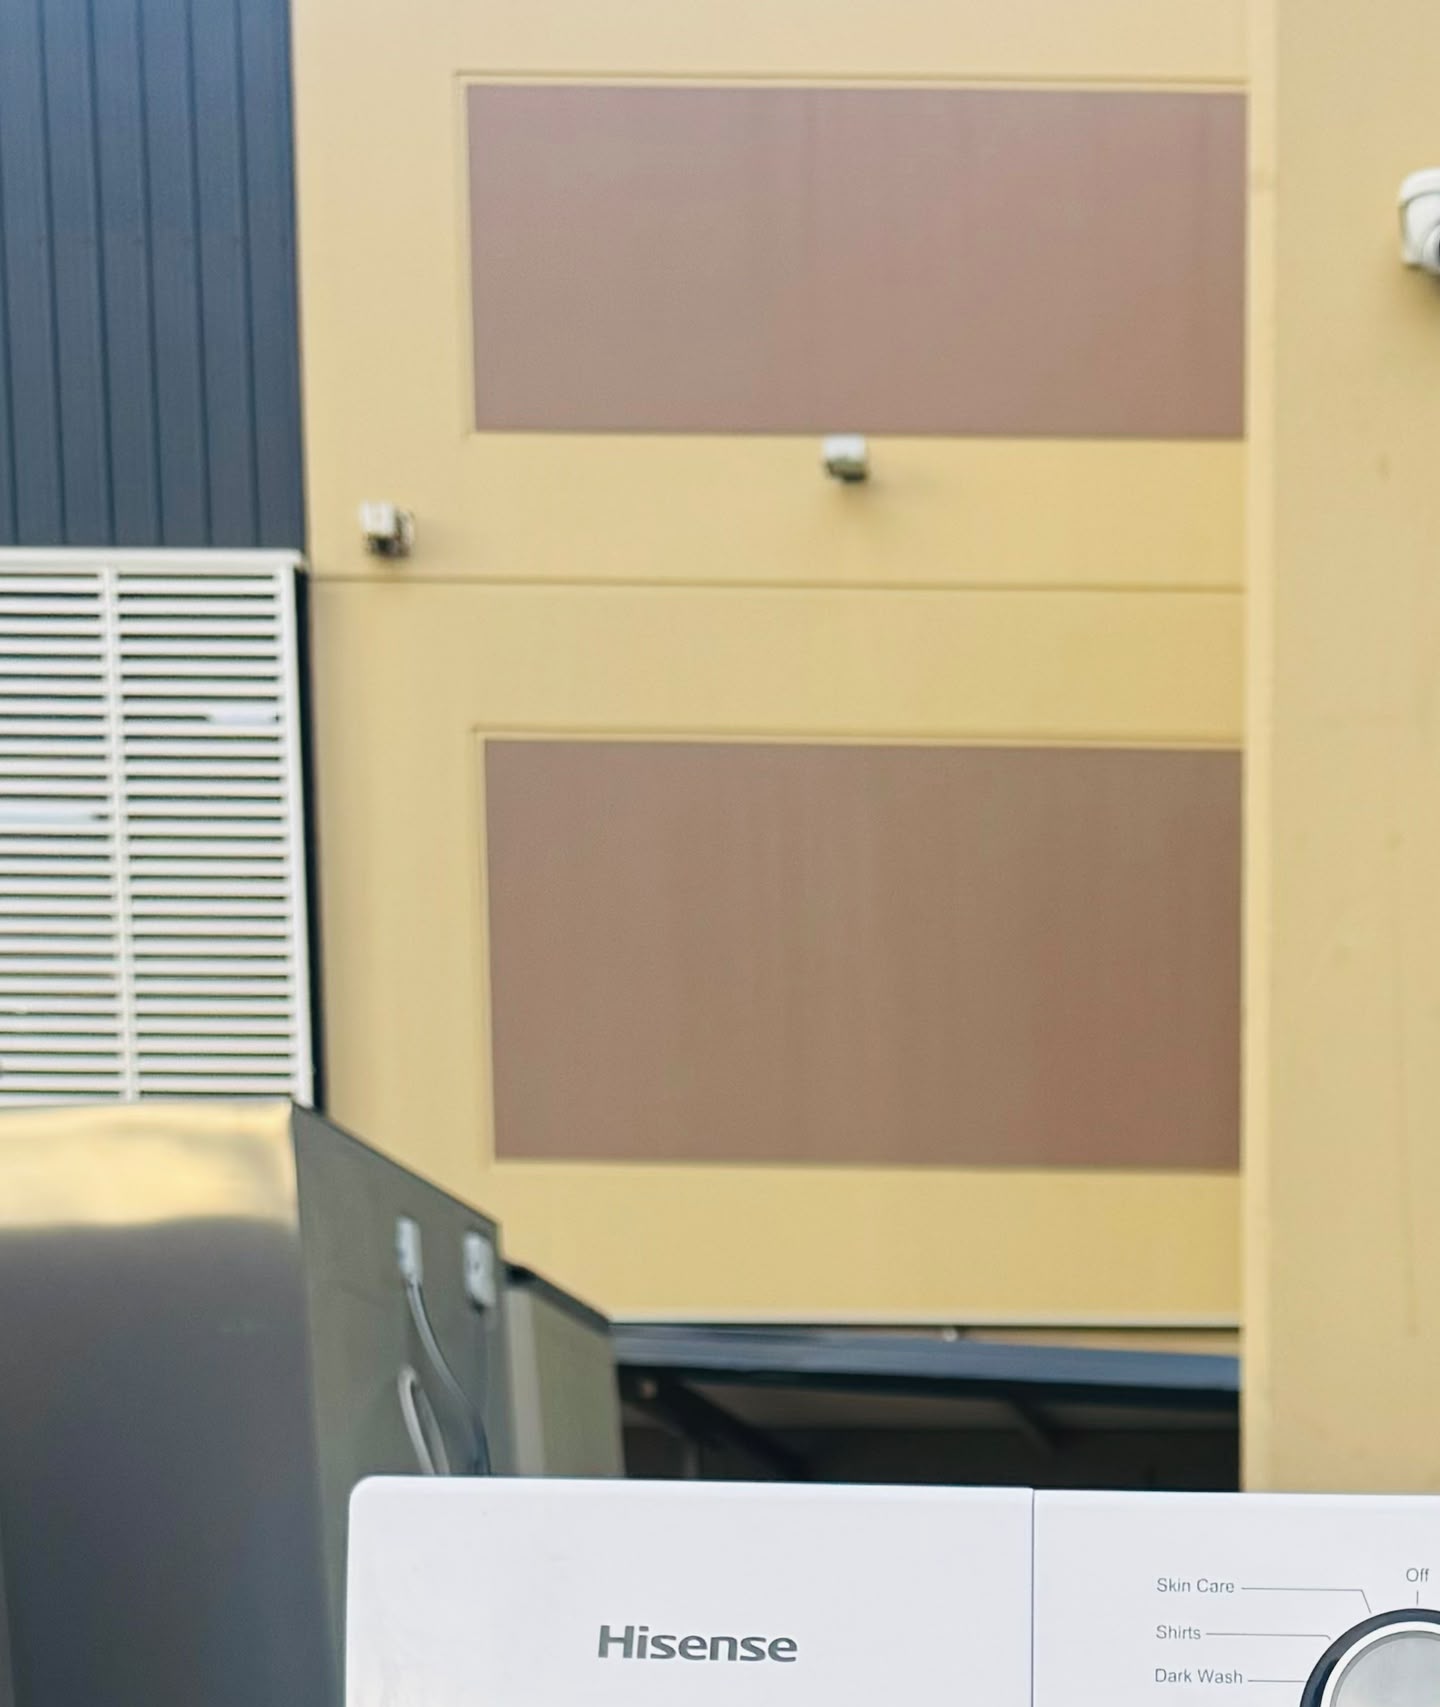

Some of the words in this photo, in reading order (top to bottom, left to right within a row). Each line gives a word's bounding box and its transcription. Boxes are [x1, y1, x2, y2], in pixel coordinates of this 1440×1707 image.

[1406, 1568, 1429, 1583] Off
[1157, 1578, 1192, 1593] Skin
[1196, 1579, 1235, 1594] Care
[1156, 1625, 1201, 1640] Shirts
[597, 1625, 798, 1662] Hisense
[1154, 1669, 1193, 1684] Dark
[1197, 1670, 1243, 1685] Wash
